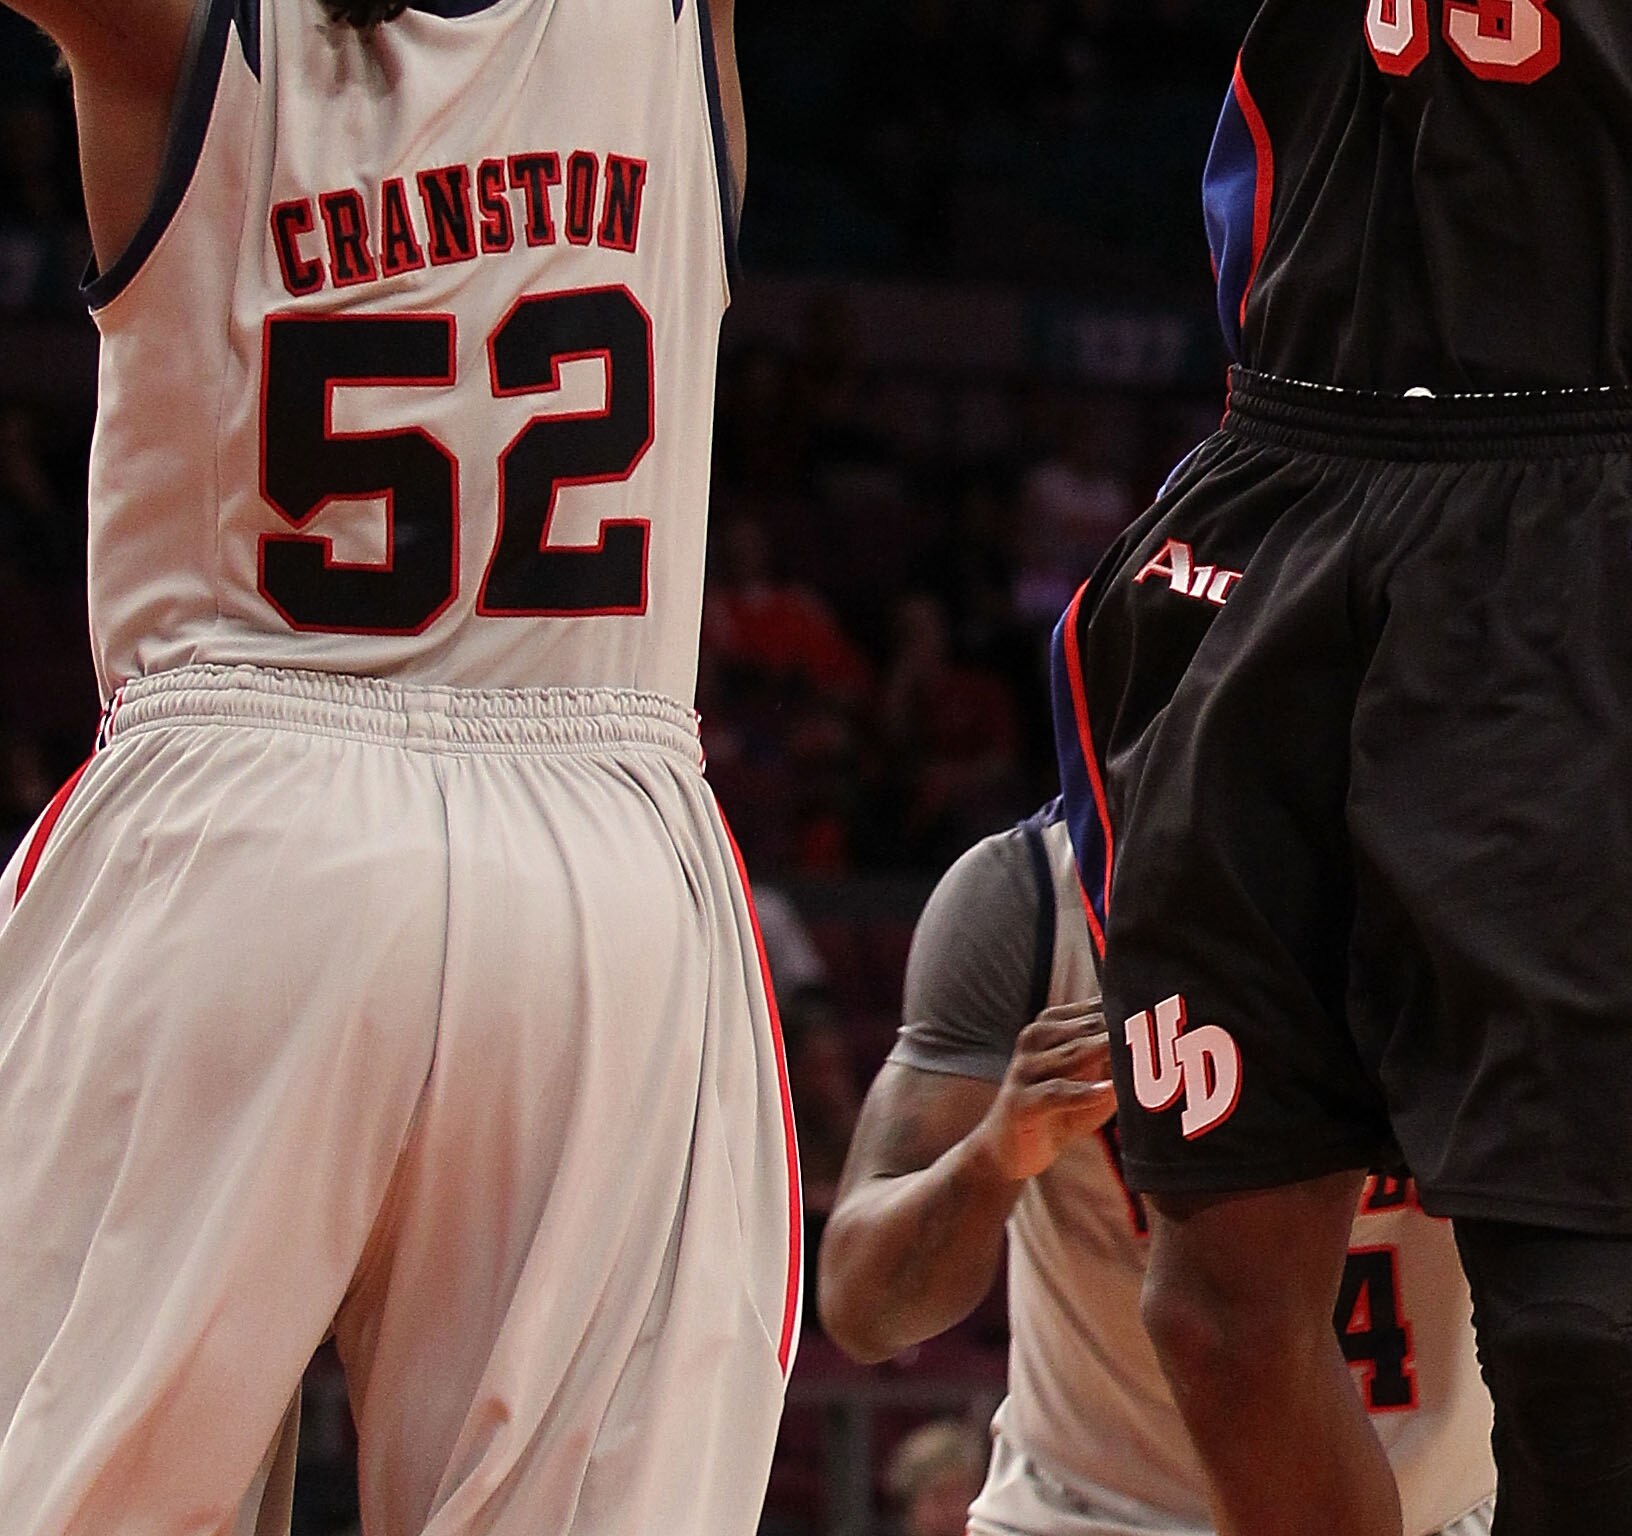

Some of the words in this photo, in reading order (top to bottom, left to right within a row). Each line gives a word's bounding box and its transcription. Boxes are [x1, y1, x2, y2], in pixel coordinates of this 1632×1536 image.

[270, 150, 648, 297] CRANSTON
[257, 284, 655, 636] 52
[1124, 993, 1243, 1141] UD
